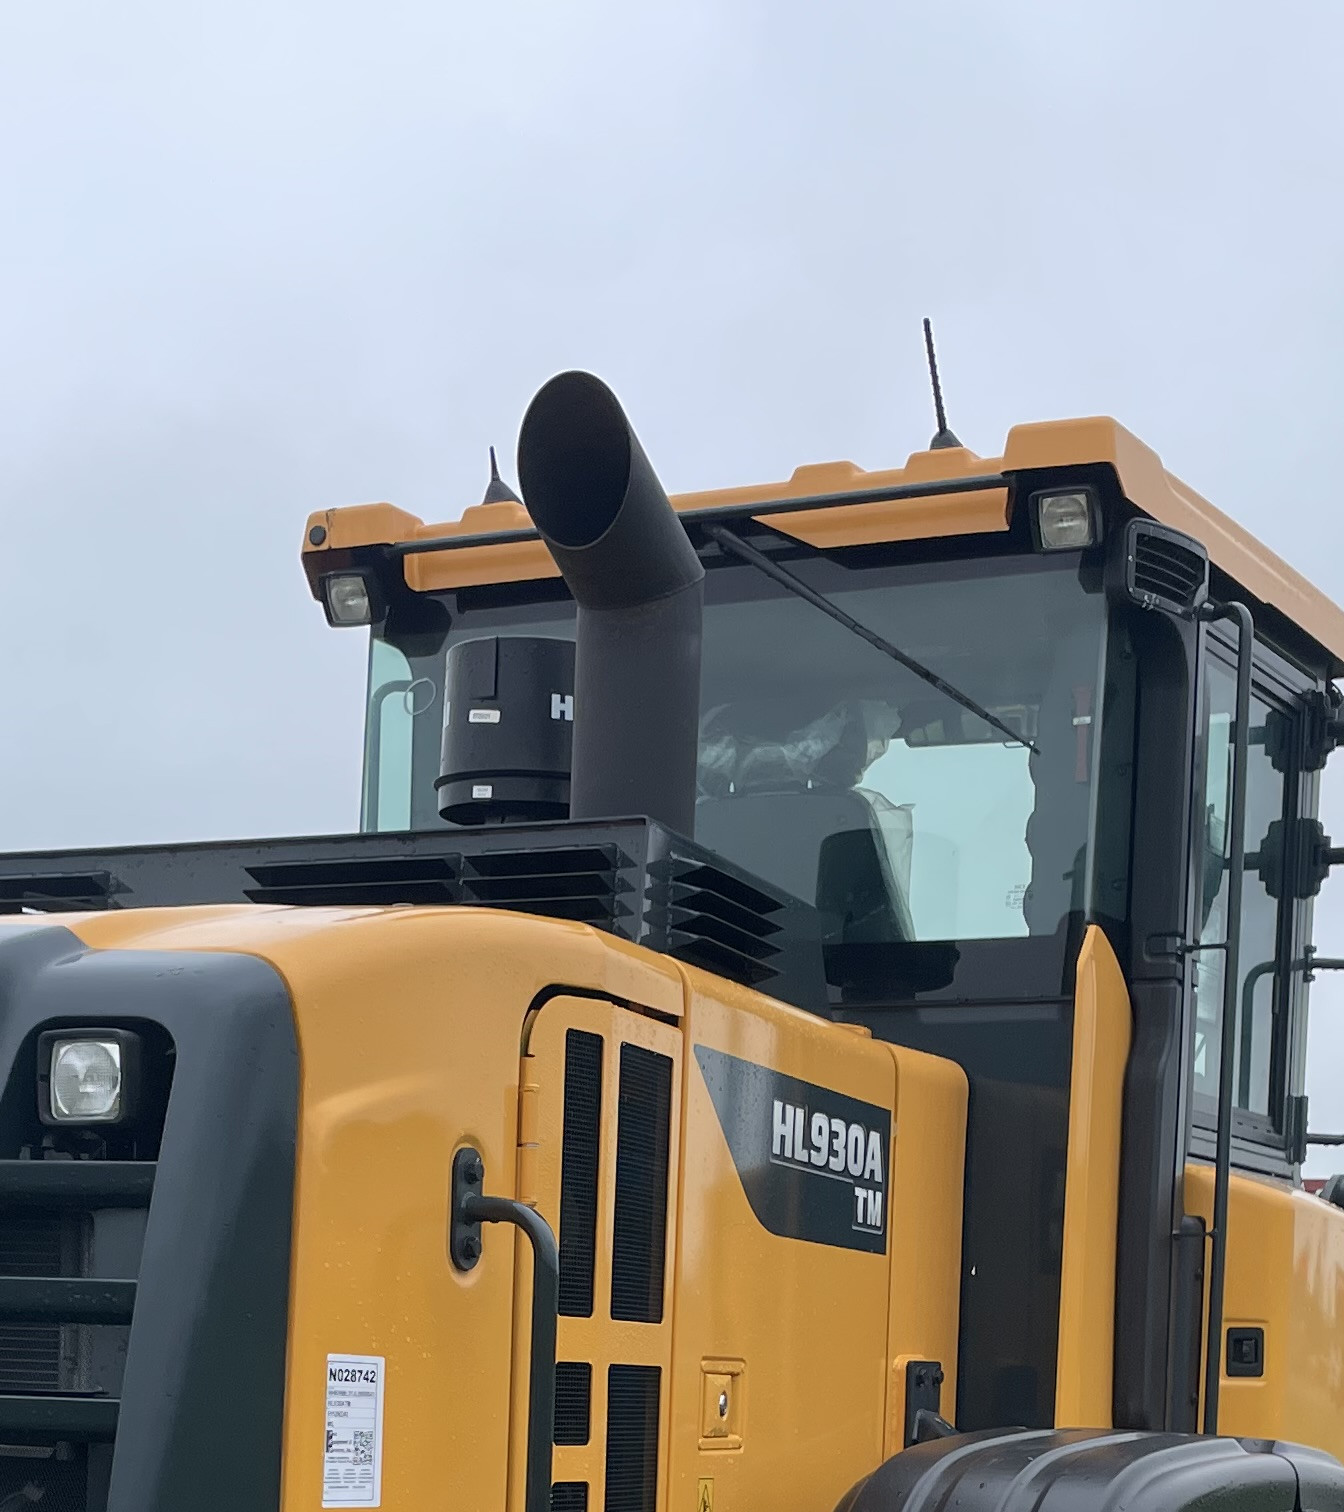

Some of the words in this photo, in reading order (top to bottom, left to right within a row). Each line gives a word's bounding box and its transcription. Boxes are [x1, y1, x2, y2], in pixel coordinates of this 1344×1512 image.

[772, 1100, 883, 1183] HL930A
[854, 1187, 882, 1227] TM
[328, 1367, 376, 1383] N028742
